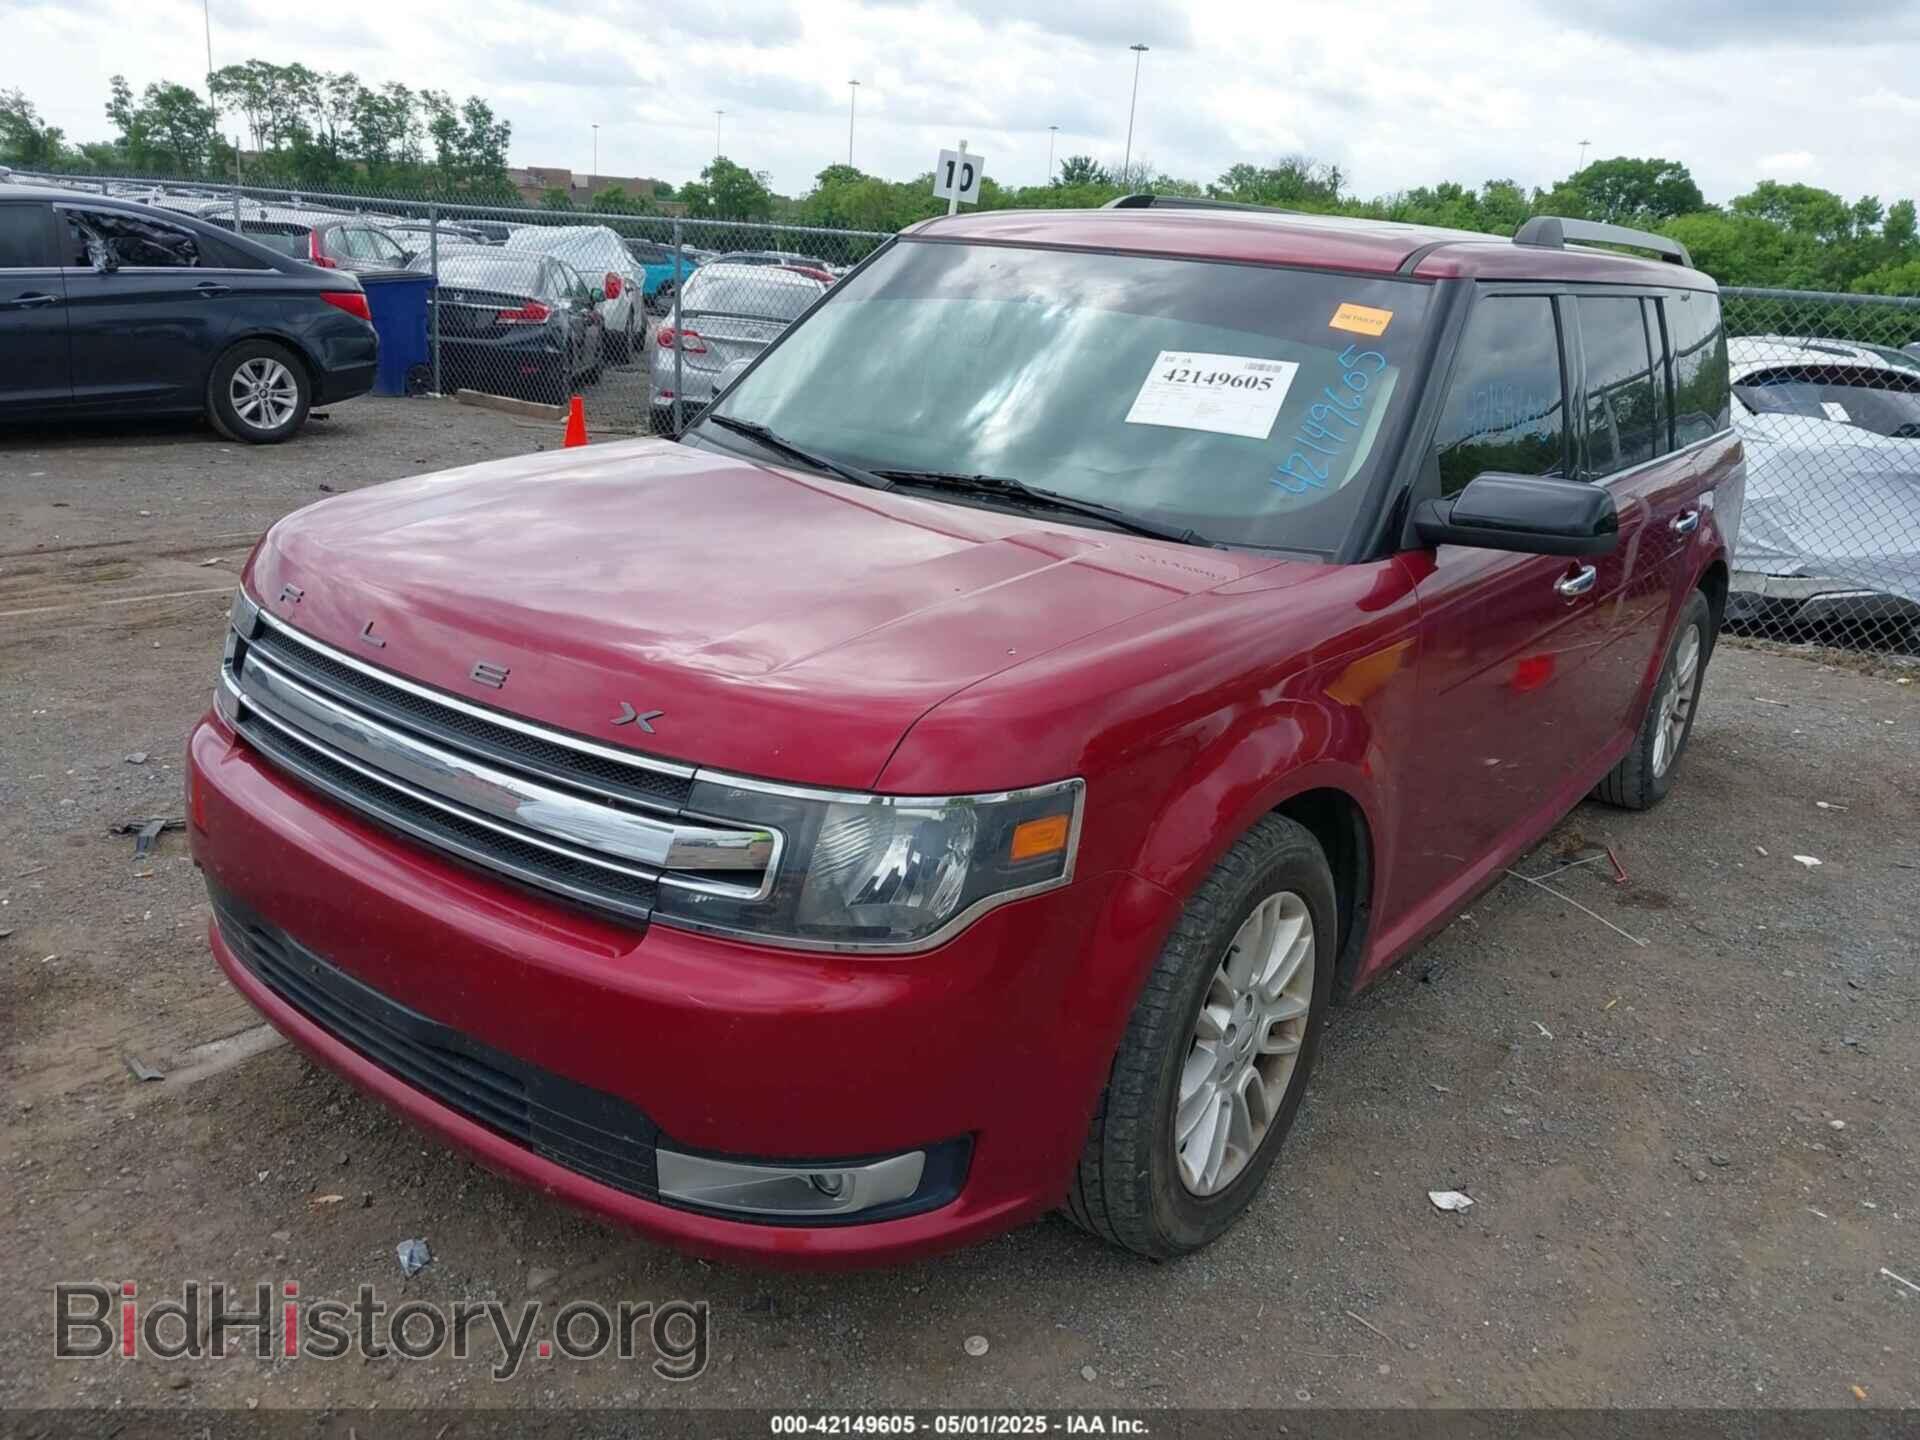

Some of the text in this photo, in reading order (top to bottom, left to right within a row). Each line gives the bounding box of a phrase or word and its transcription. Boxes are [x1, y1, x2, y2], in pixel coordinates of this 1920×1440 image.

[946, 160, 974, 192] 10
[1162, 368, 1275, 391] 42149605
[279, 583, 665, 734] FLEX
